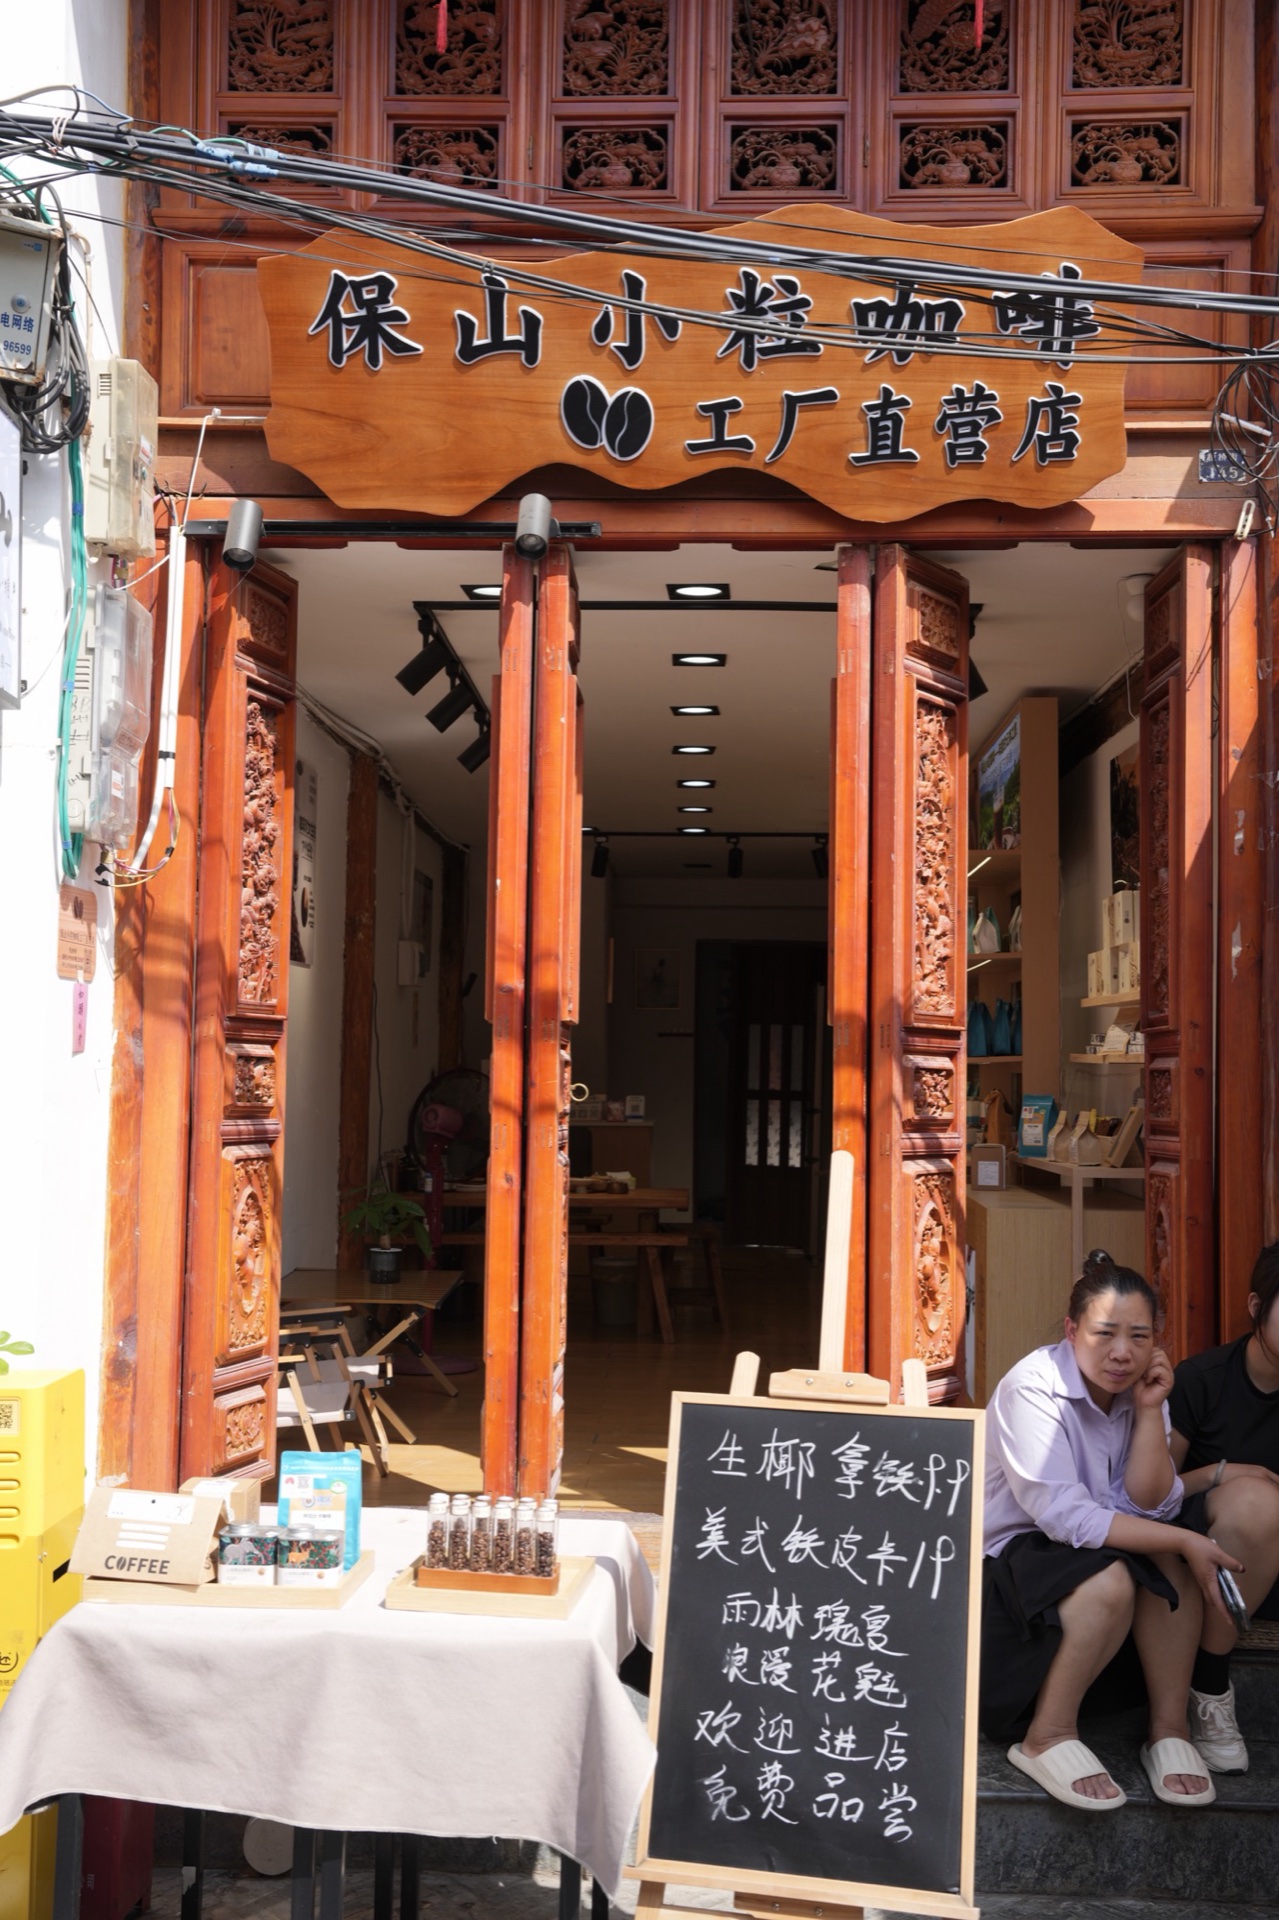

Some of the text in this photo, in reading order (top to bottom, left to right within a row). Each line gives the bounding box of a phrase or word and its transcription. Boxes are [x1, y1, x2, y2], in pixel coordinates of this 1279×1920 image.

[3, 340, 32, 356] 96599
[308, 263, 1101, 371] 保山小粒咖啡
[684, 380, 1082, 468] 工厂直营店
[104, 1555, 171, 1575] COFFEE
[721, 1587, 909, 1657] 雨林瑰夏
[721, 1642, 907, 1708] 浪漫花魁
[694, 1700, 909, 1772] 欢迎进店
[703, 1760, 918, 1843] 免费品尝
